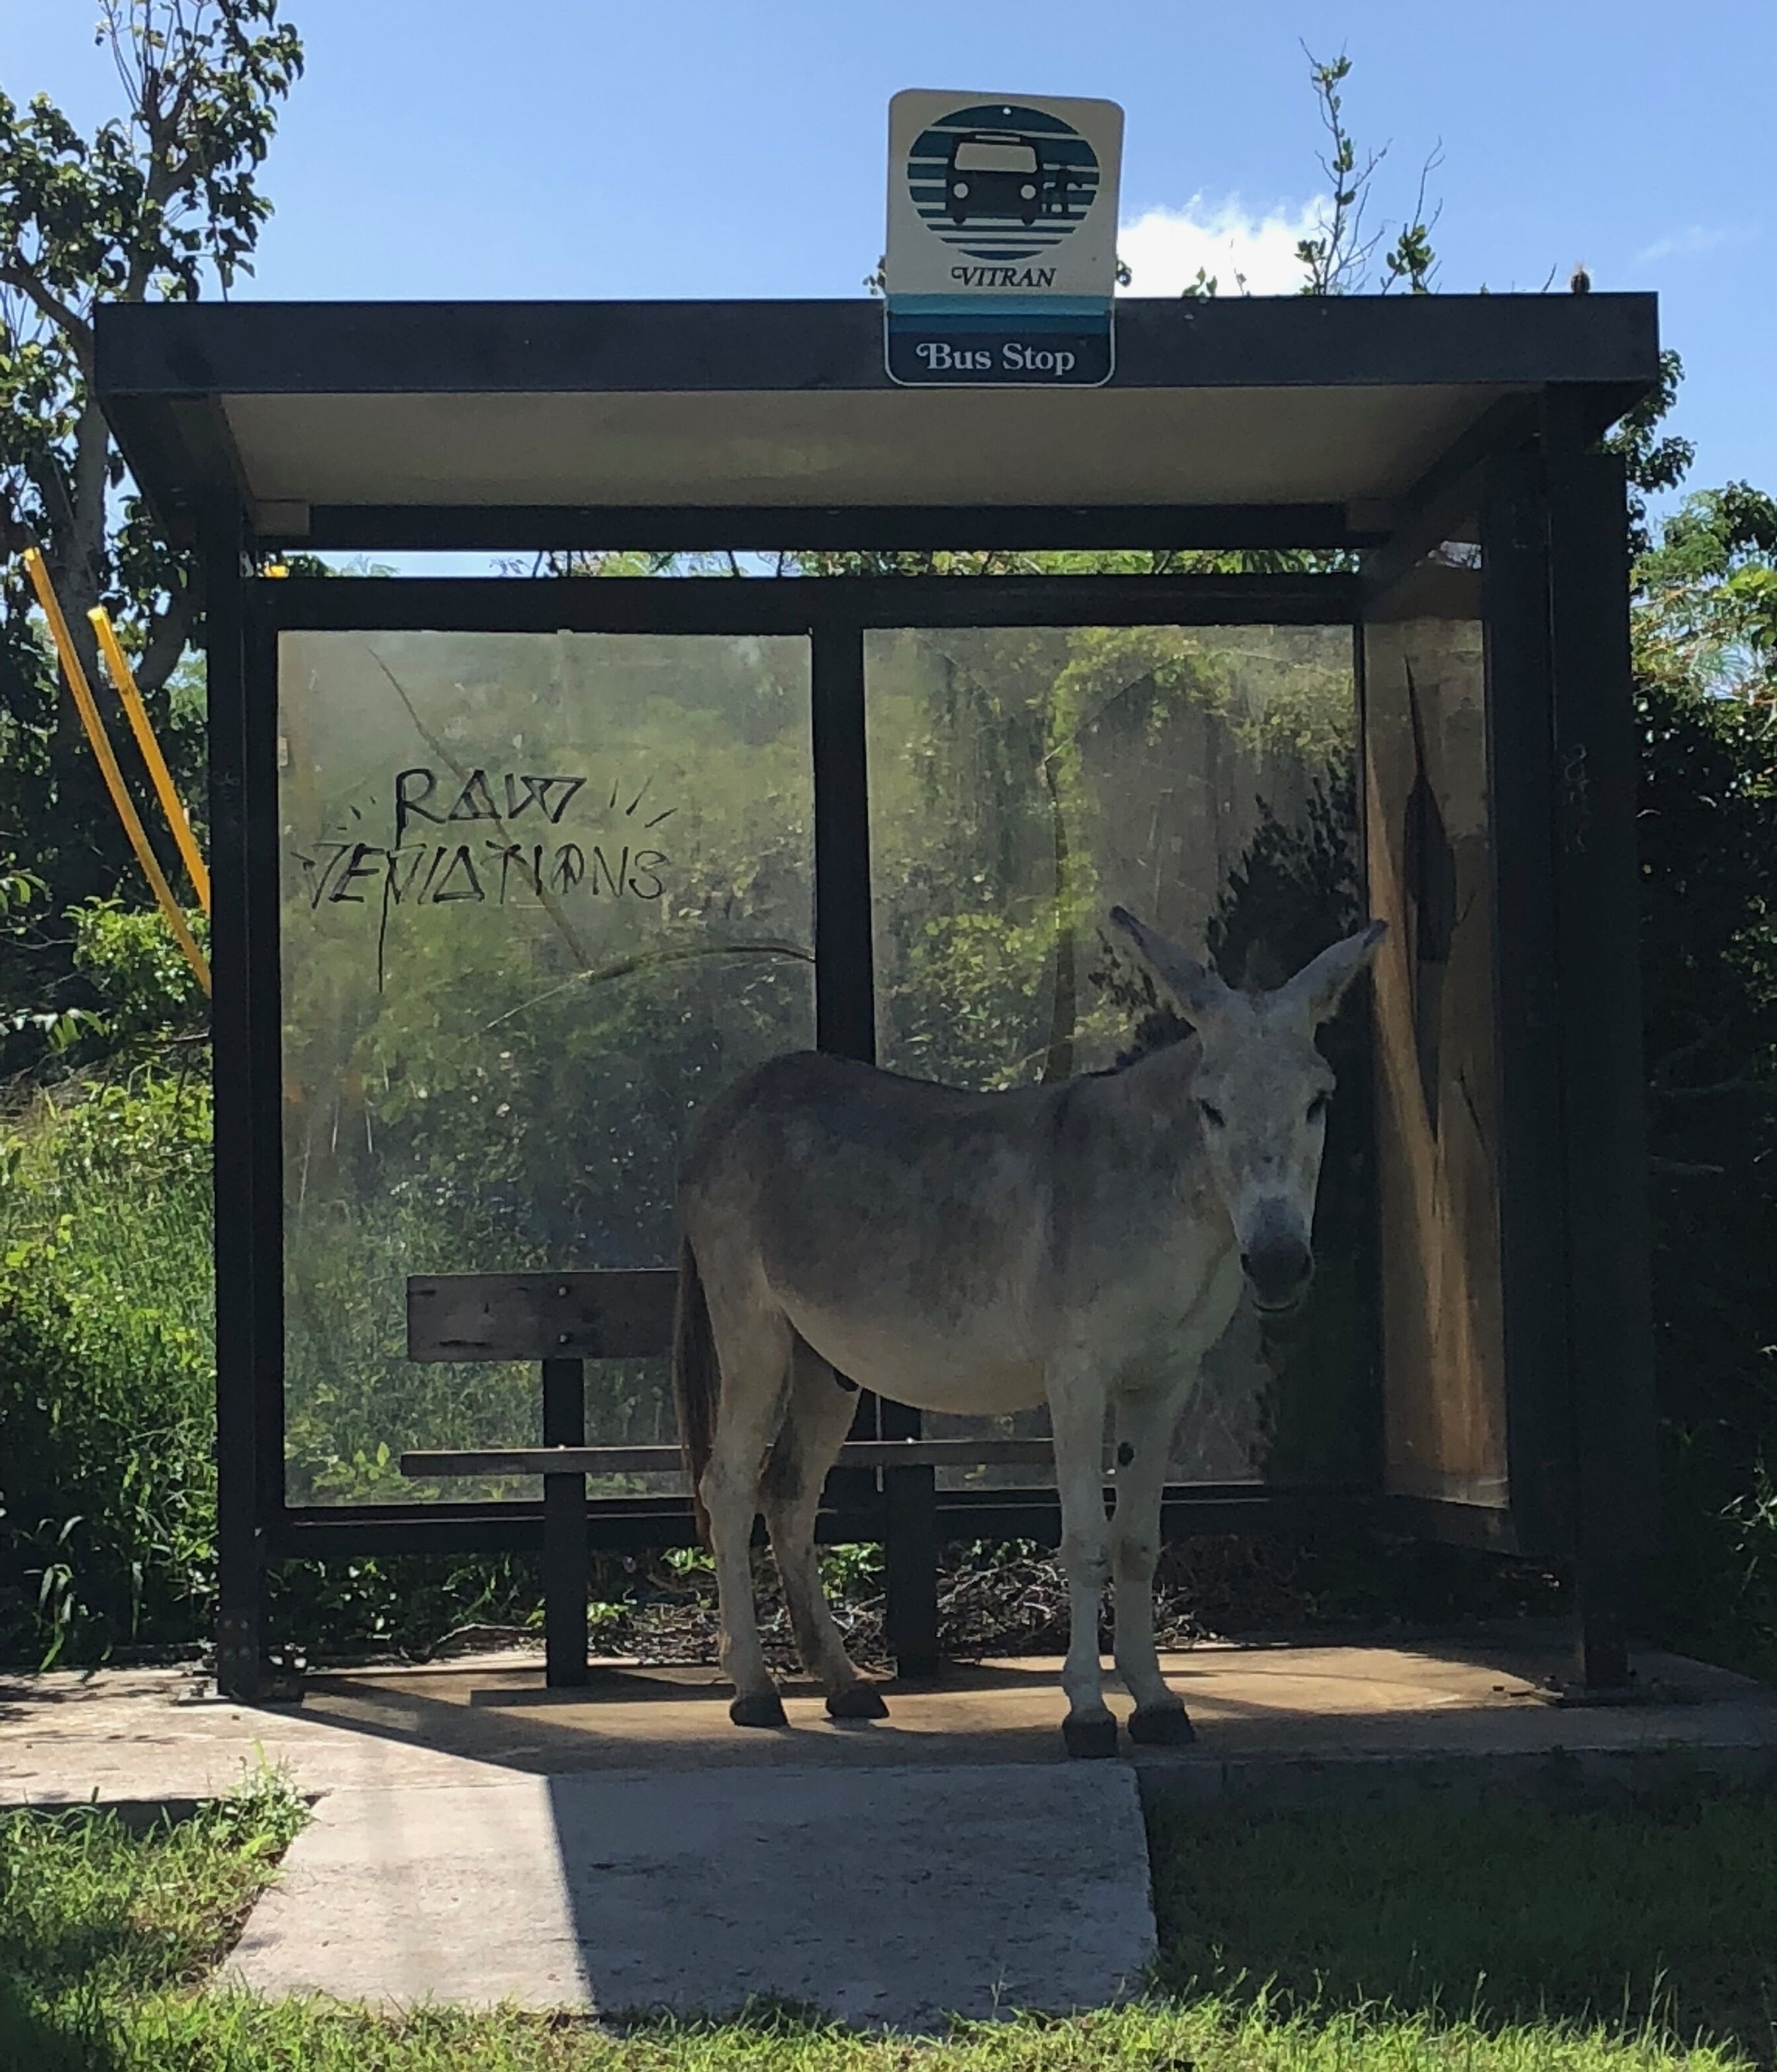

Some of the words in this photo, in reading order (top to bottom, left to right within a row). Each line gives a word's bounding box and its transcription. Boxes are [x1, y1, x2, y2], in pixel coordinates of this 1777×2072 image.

[951, 266, 1057, 287] VITRAN
[916, 342, 992, 370] Bus
[1002, 342, 1075, 376] Stop
